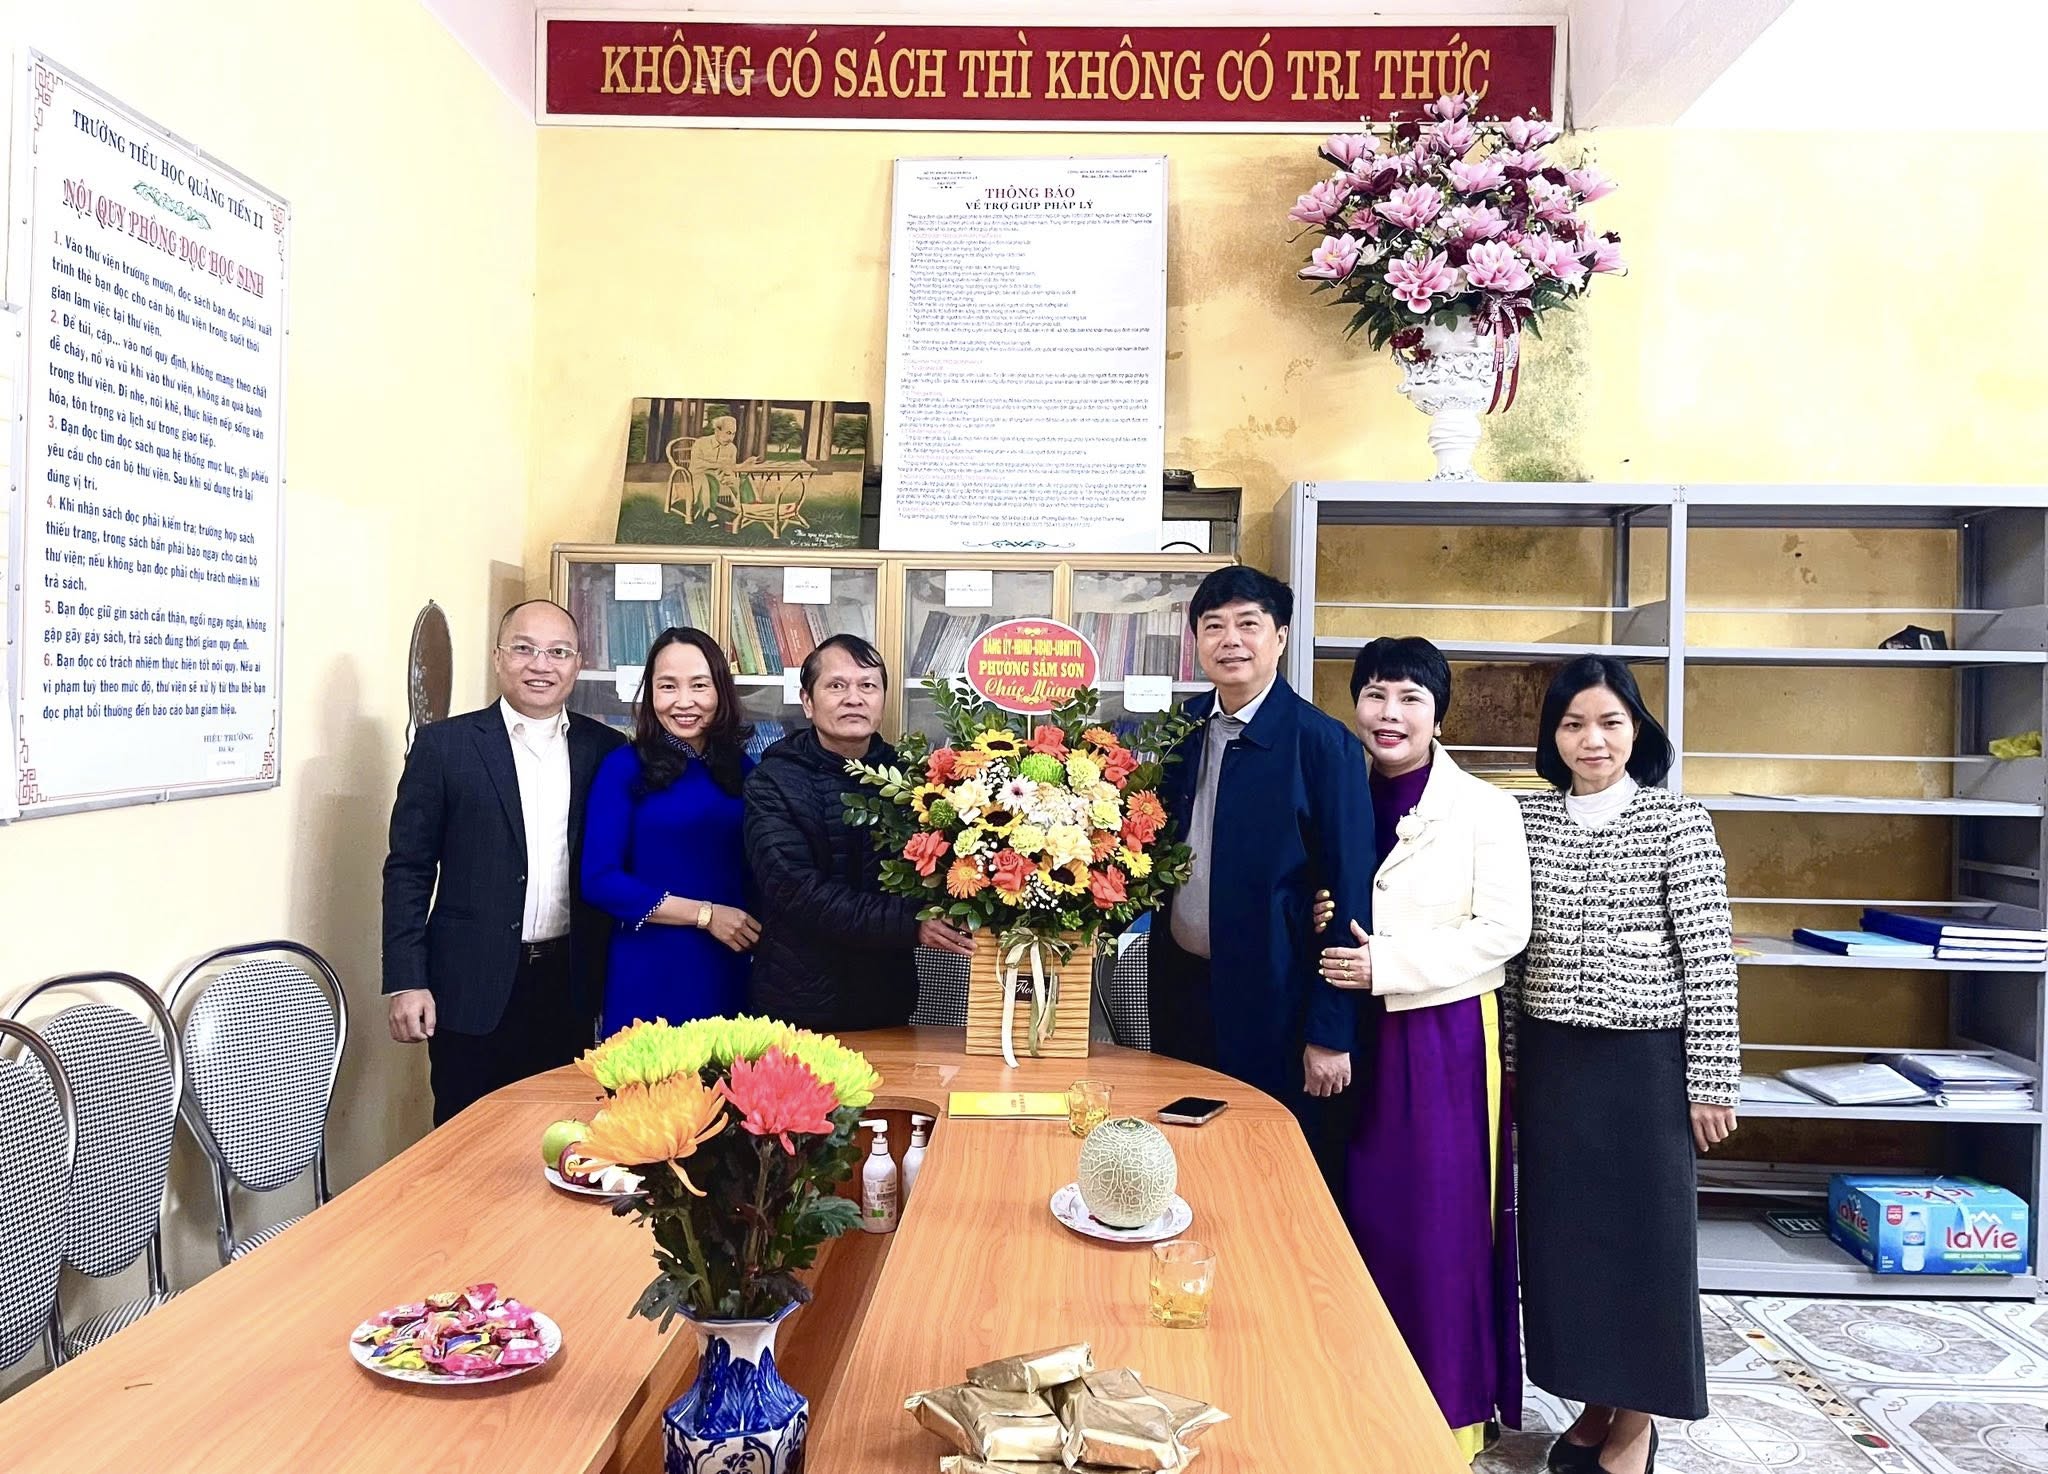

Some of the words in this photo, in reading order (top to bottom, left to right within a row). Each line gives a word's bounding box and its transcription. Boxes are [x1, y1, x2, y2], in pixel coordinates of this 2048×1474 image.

[601, 30, 754, 96] KHÔNG
[767, 29, 821, 97] CÓ
[835, 32, 947, 98] SÁCH
[959, 31, 1032, 98] THÌ
[1045, 35, 1204, 100] KHÔNG
[1217, 33, 1273, 101] CÓ
[1288, 51, 1360, 100] TRI
[1375, 32, 1490, 100] THỨC
[72, 109, 125, 152] TRƯỜNG
[128, 140, 158, 172] TIỂU
[160, 158, 185, 187] HỌC
[187, 175, 225, 209] QUẢNG
[227, 196, 252, 224] TIẾN
[252, 211, 264, 231] II
[966, 198, 981, 210] VỀ
[984, 201, 1009, 212] TRỢ
[1011, 200, 1041, 210] GIÚP
[1044, 199, 1076, 210] PHÁP
[984, 184, 1040, 199] THÔNG
[1044, 184, 1075, 199] BÁO
[53, 230, 63, 247] 1.
[84, 243, 101, 263] thư
[101, 252, 120, 272] viện
[61, 177, 93, 220] NỘI
[94, 194, 127, 233] QUY
[127, 210, 177, 258] PHÒNG
[178, 235, 207, 273] ĐỌC
[207, 250, 235, 286] HỌC
[236, 264, 265, 299] SINH
[94, 273, 112, 293] bạn
[113, 282, 130, 300] đọc
[50, 284, 72, 303] gian
[92, 300, 111, 319] việc
[113, 306, 126, 325] tại
[50, 308, 60, 325] 2.
[78, 319, 94, 340] túi,
[122, 336, 139, 353] vào
[104, 355, 115, 370] và
[49, 361, 75, 385] trong
[76, 370, 94, 388] thư
[94, 376, 116, 395] viện.
[117, 382, 128, 399] Đi
[71, 394, 88, 412] tôn
[89, 400, 115, 422] trọng
[116, 408, 127, 423] và
[48, 414, 58, 430] 3.
[60, 417, 80, 437] Bạn
[81, 423, 99, 442] đọc
[116, 433, 133, 451] đọc
[46, 442, 65, 458] yêu
[86, 450, 103, 467] cho
[104, 455, 121, 471] cán
[123, 458, 135, 474] bộ
[46, 467, 71, 489] đúng
[72, 473, 82, 491] vị
[83, 475, 98, 492] trí.
[46, 494, 56, 509] 4.
[58, 495, 75, 513] Khi
[77, 500, 100, 518] nhận
[101, 505, 123, 521] sách
[124, 508, 140, 526] đọc
[45, 520, 71, 537] thiếu
[72, 524, 100, 544] trang,
[102, 529, 127, 549] trong
[44, 546, 63, 563] thư
[63, 549, 86, 568] viện;
[88, 552, 105, 568] nếu
[106, 554, 134, 574] không
[44, 572, 60, 589] trả
[61, 575, 87, 592] sách.
[44, 599, 54, 615] 5.
[56, 600, 76, 619] Bạn
[78, 602, 95, 620] đọc
[43, 626, 63, 644] gập
[103, 629, 127, 646] sách,
[43, 652, 53, 667] 6.
[56, 652, 75, 670] Bạn
[77, 653, 94, 671] đọc
[96, 654, 108, 668] có
[109, 654, 133, 669] trách
[978, 656, 1030, 677] PHƯỜNG
[1032, 655, 1058, 678] SẦM
[1060, 661, 1085, 679] SƠN
[42, 678, 52, 694] vi
[54, 678, 81, 696] phạm
[99, 679, 120, 693] theo
[984, 677, 1025, 696] Chúc
[42, 705, 60, 722] đọc
[62, 704, 84, 722] phạt
[1946, 1224, 2018, 1249] laVie
